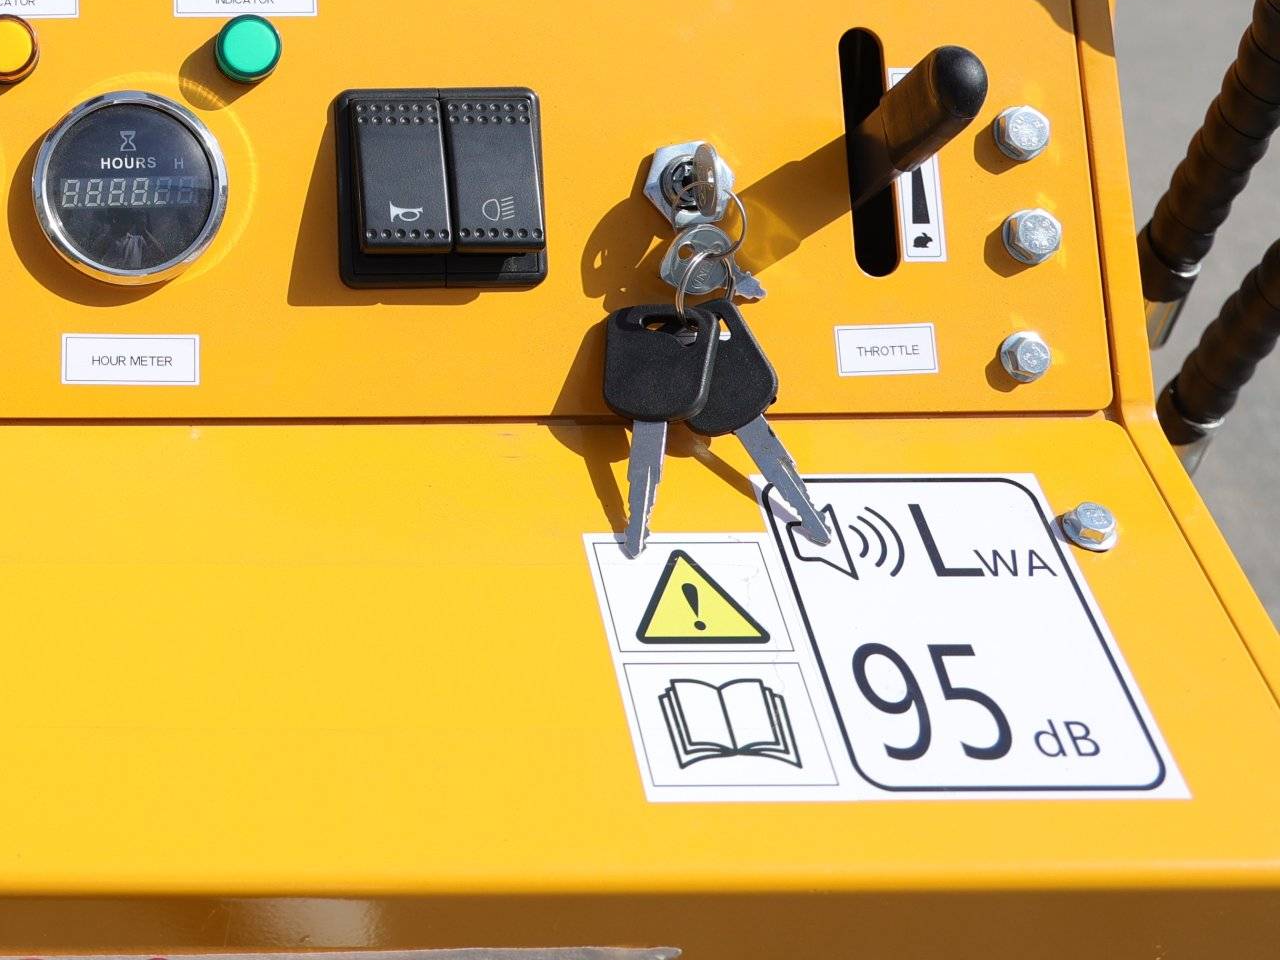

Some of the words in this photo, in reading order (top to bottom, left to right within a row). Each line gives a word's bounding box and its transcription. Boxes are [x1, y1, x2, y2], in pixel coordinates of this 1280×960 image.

[100, 157, 157, 170] HOURS
[173, 158, 184, 170] H
[855, 344, 920, 357] THROTTLE
[91, 354, 126, 367] HOUR
[128, 354, 174, 367] METER
[851, 642, 1014, 762] 95
[1033, 719, 1101, 758] dB
